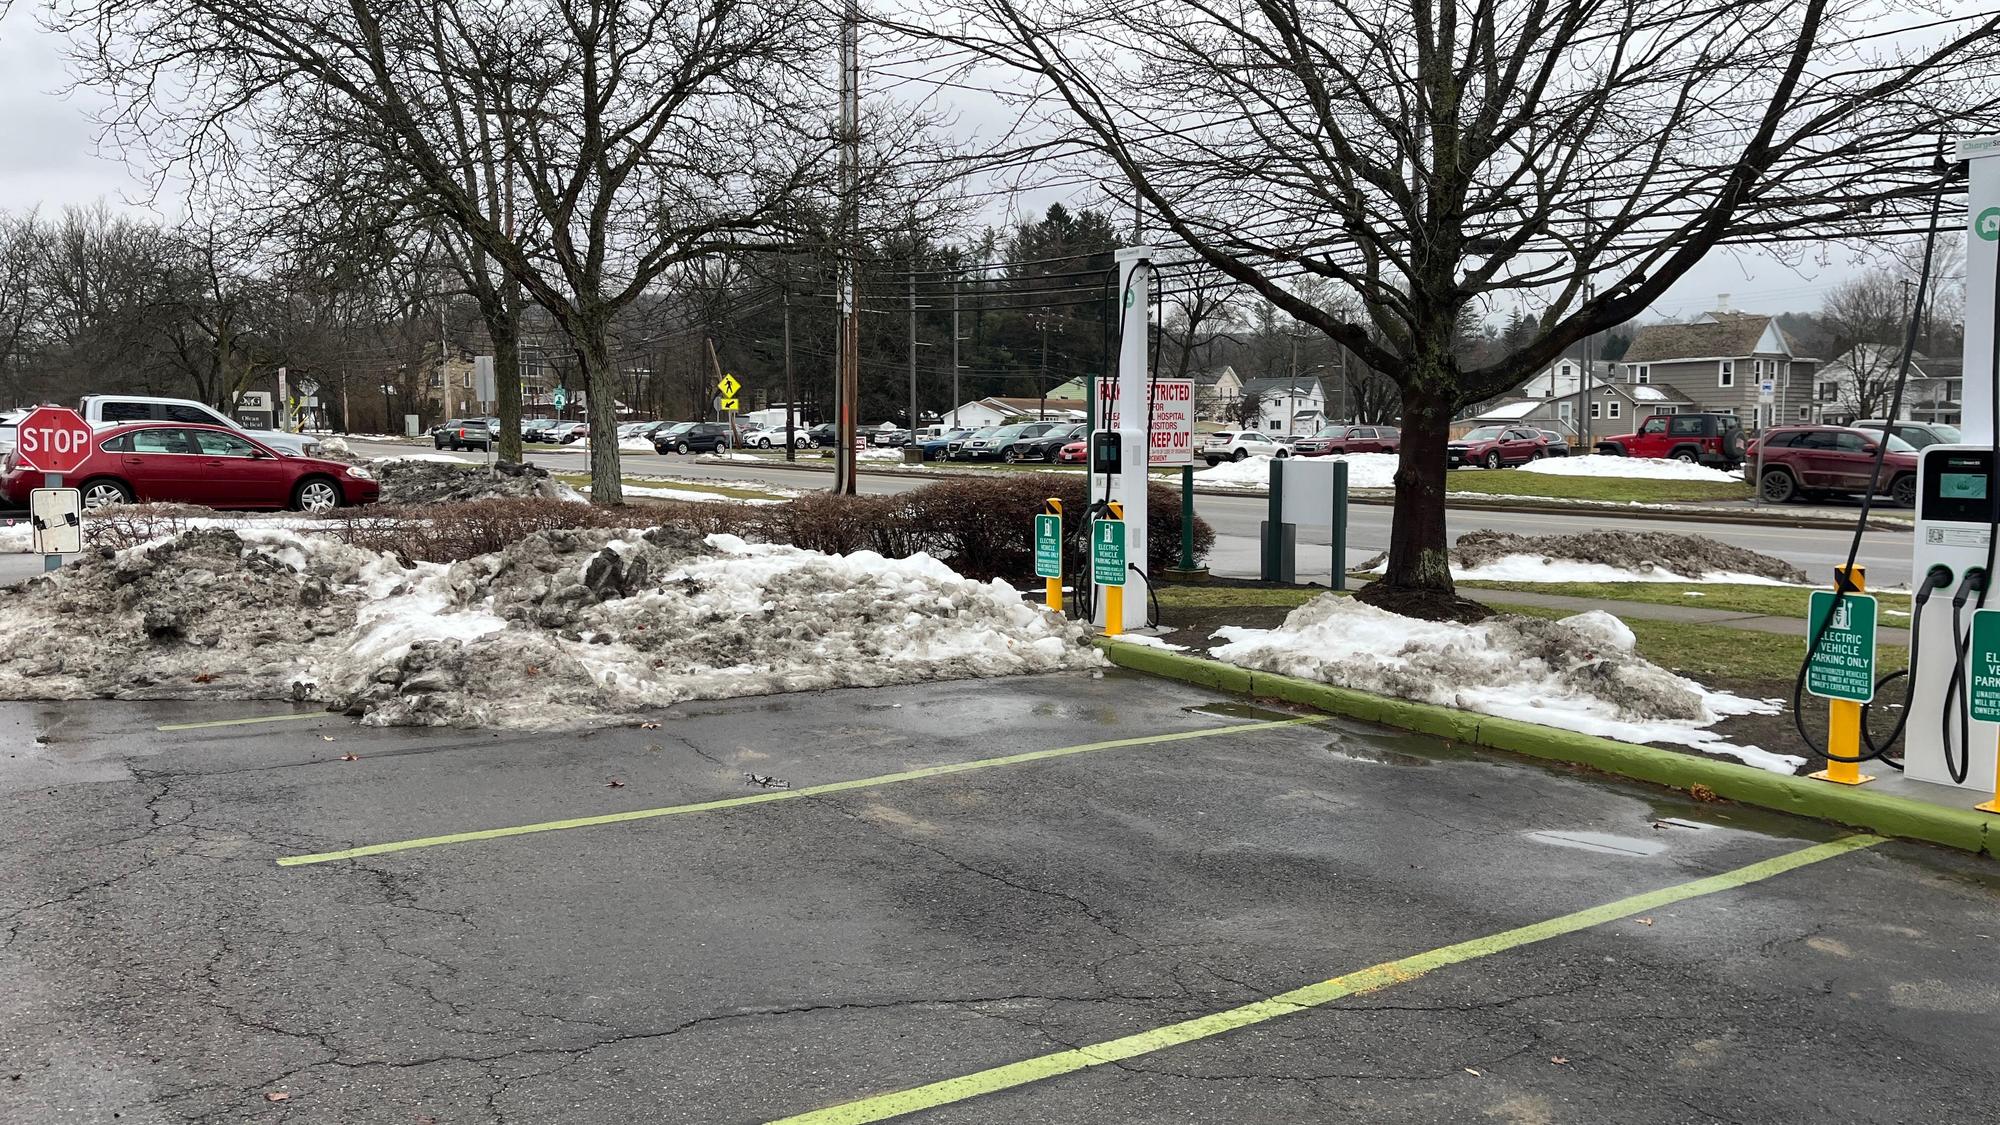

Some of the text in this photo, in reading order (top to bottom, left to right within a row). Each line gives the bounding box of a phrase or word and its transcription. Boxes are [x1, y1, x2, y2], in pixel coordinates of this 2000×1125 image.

[1157, 412, 1185, 420] HOSPITAL
[1151, 422, 1178, 430] VISITORS
[23, 427, 88, 453] STOP
[1151, 432, 1190, 448] KEEP OUT
[1040, 537, 1056, 545] ELECTRIC
[1095, 557, 1124, 566] PARKING ONLY
[1820, 631, 1862, 644] LECTRIC
[1821, 642, 1859, 656] VEHICLE
[1811, 652, 1869, 669] PARKING ONLY
[1812, 665, 1868, 679] UNAUTHORIZED VEHICLES
[1988, 664, 2000, 676] VE
[1811, 672, 1821, 680] WILL
[1827, 675, 1842, 683] TOWED
[1849, 678, 1868, 687] VEHICLE
[1975, 675, 2000, 688] PARK
[1811, 680, 1830, 689] OWNER'S
[1830, 683, 1850, 692] EXPENSE
[1857, 686, 1868, 694] RISK
[1974, 698, 1988, 707] WILL
[1989, 699, 1997, 708] BE
[1974, 706, 2000, 716] OWNER'S
